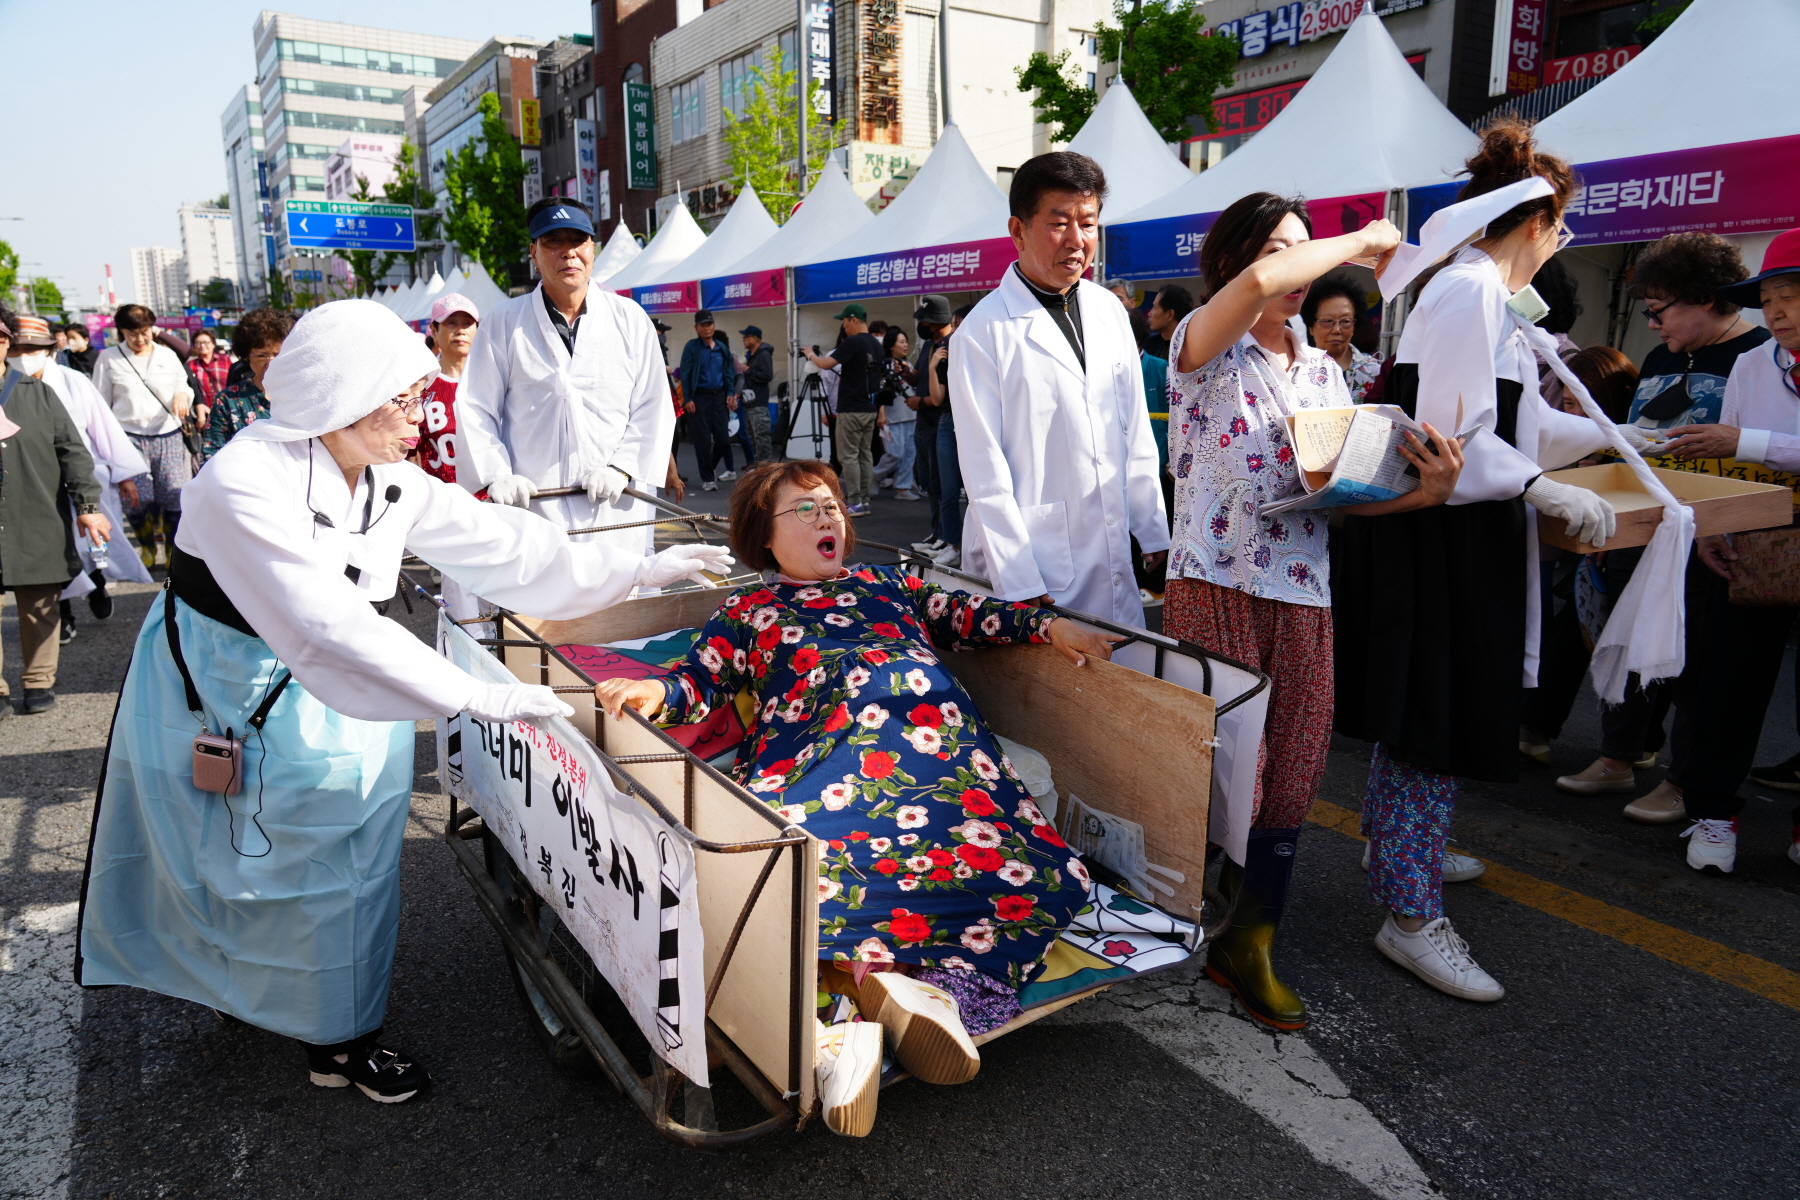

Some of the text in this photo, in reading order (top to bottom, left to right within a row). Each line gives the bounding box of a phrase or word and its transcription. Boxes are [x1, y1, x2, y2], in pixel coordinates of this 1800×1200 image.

[1513, 5, 1540, 71] 화방
[1236, 60, 1297, 82] STAURANT
[1553, 50, 1629, 80] 7080
[629, 87, 649, 99] The
[1508, 71, 1537, 93] 전화방
[1213, 101, 1246, 132] 전국
[633, 102, 649, 174] 예쁨헤어
[580, 129, 596, 185] 아리랑
[865, 153, 910, 180] 쟁반
[1564, 170, 1725, 217] 북문화재단
[335, 217, 367, 230] 도봉로
[857, 249, 980, 285] 합동상황실 운영본부
[552, 774, 645, 921] 이발사
